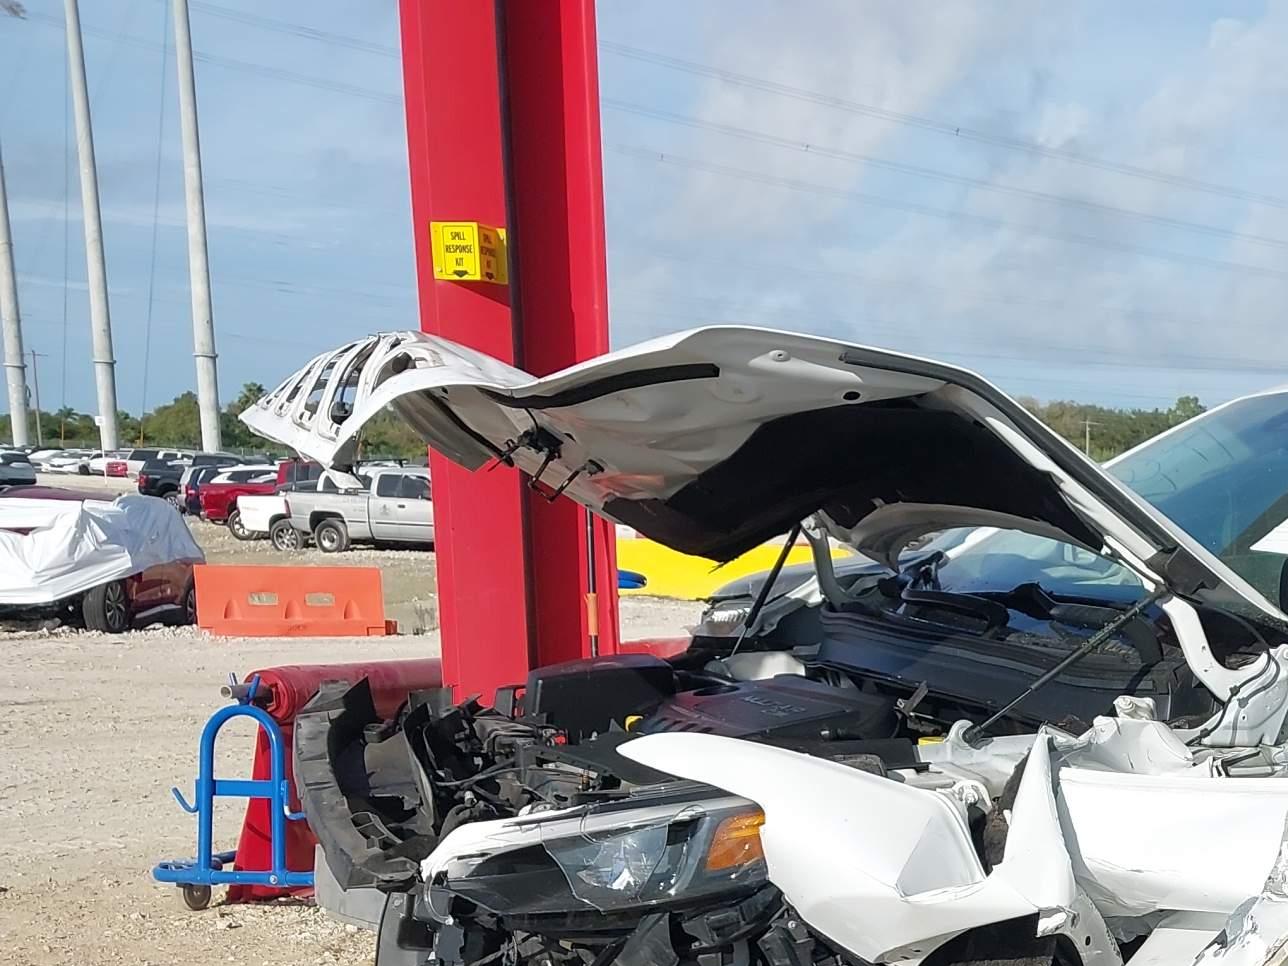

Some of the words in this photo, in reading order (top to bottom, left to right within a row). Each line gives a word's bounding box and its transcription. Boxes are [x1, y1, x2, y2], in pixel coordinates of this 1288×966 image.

[451, 231, 466, 241] SPILL
[445, 244, 473, 254] RESPONSE
[455, 257, 464, 267] KIT
